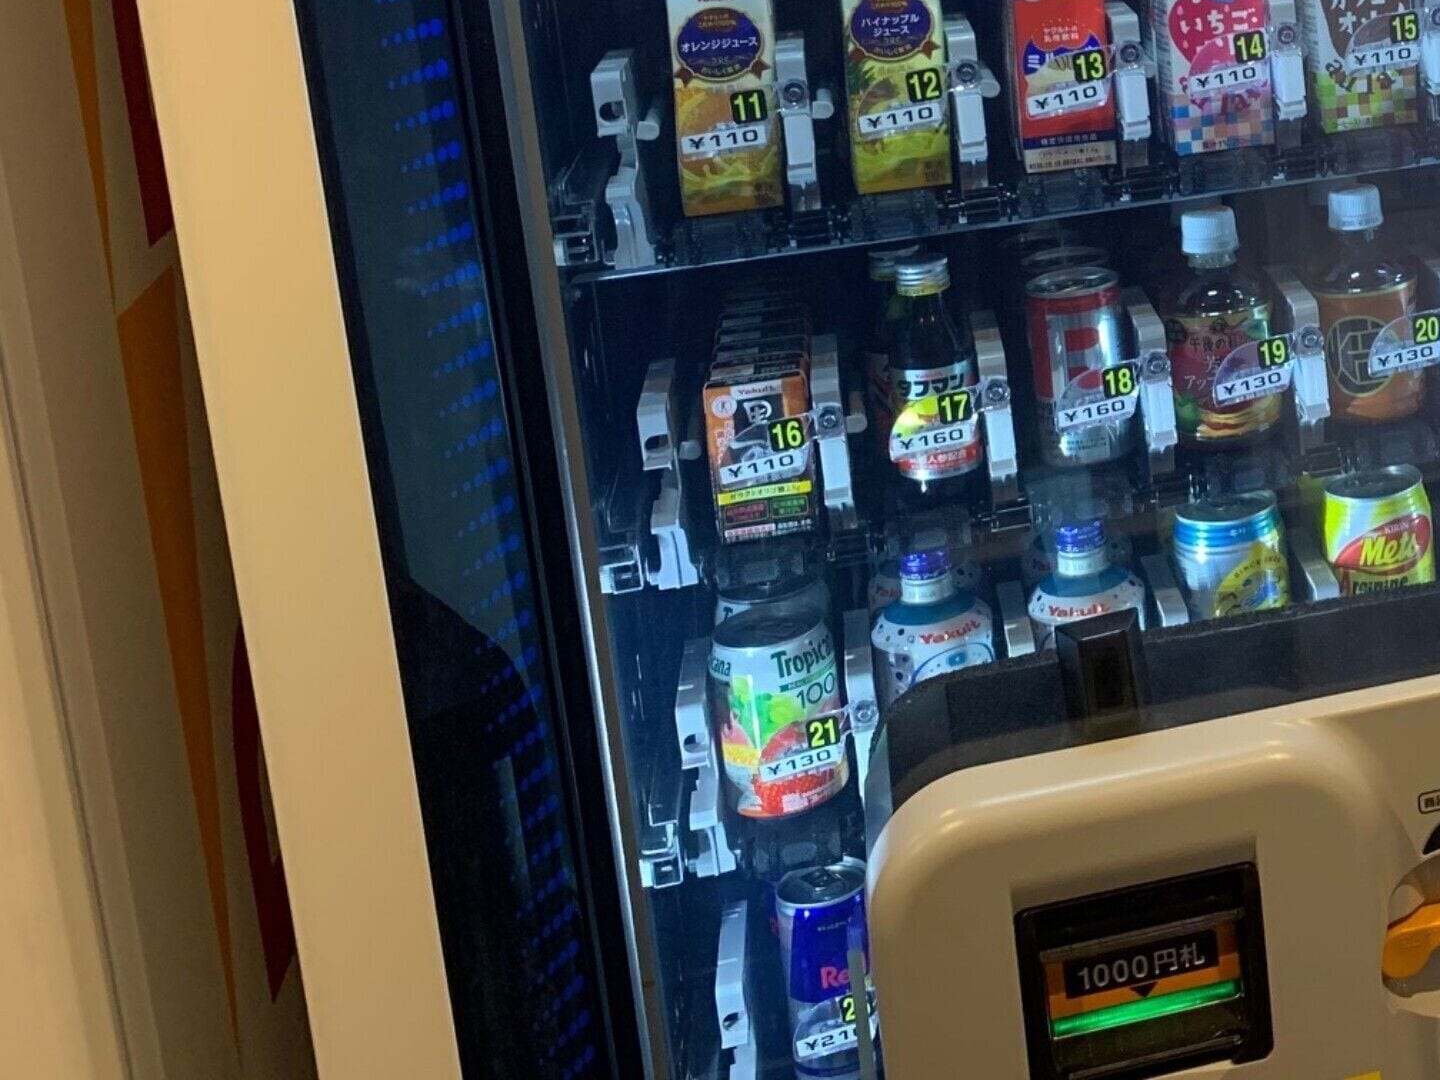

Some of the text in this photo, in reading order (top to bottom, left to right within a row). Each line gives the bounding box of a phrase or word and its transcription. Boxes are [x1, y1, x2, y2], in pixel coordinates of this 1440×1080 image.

[1391, 14, 1417, 42] 15
[680, 36, 758, 54] オレンジジュース
[1236, 34, 1264, 61] 14
[1354, 47, 1412, 66] ¥110
[1076, 51, 1104, 80] 13
[1195, 66, 1257, 89] ¥110
[908, 71, 939, 101] 12
[1035, 85, 1098, 110] ¥110
[733, 92, 764, 121] 11
[868, 106, 934, 129] ¥110
[689, 129, 758, 150] ¥110
[1415, 316, 1439, 343] 20
[1259, 339, 1287, 367] 19
[1377, 345, 1434, 368] ¥130
[1104, 367, 1133, 396] 18
[1222, 372, 1282, 396] ¥130
[940, 392, 969, 422] 17
[1063, 399, 1126, 422] ¥160
[771, 420, 802, 450] 16
[899, 428, 964, 450] ¥160
[727, 453, 795, 479] ¥110
[1359, 531, 1418, 568] Mets
[918, 619, 981, 645] Yakult
[809, 718, 837, 747] 21
[769, 749, 832, 775] ¥130
[820, 966, 851, 990] Re
[1077, 942, 1206, 990] 1000円札
